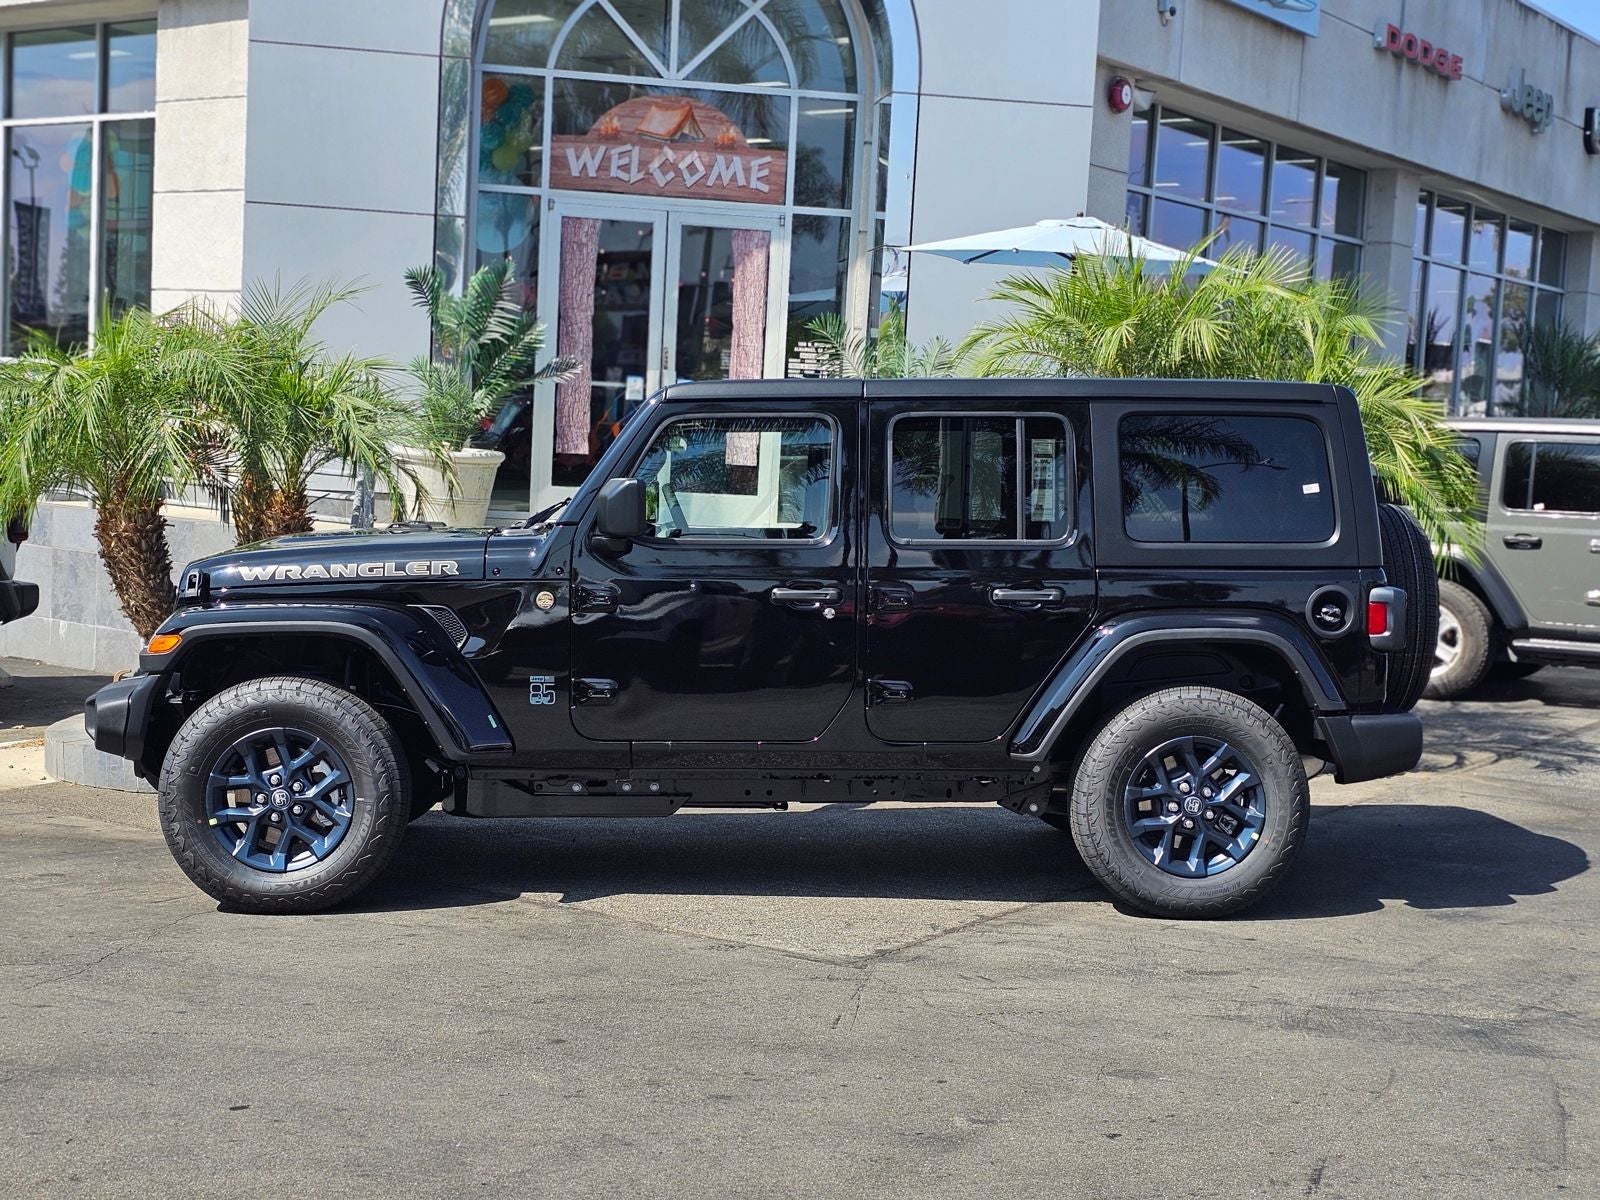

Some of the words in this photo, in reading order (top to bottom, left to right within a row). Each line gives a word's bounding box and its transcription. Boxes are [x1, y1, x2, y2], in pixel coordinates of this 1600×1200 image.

[1386, 23, 1464, 81] DODGE
[1508, 67, 1554, 135] Jeep
[565, 143, 773, 194] WELCOME
[237, 560, 460, 581] WRANGLER
[530, 683, 556, 705] 85
